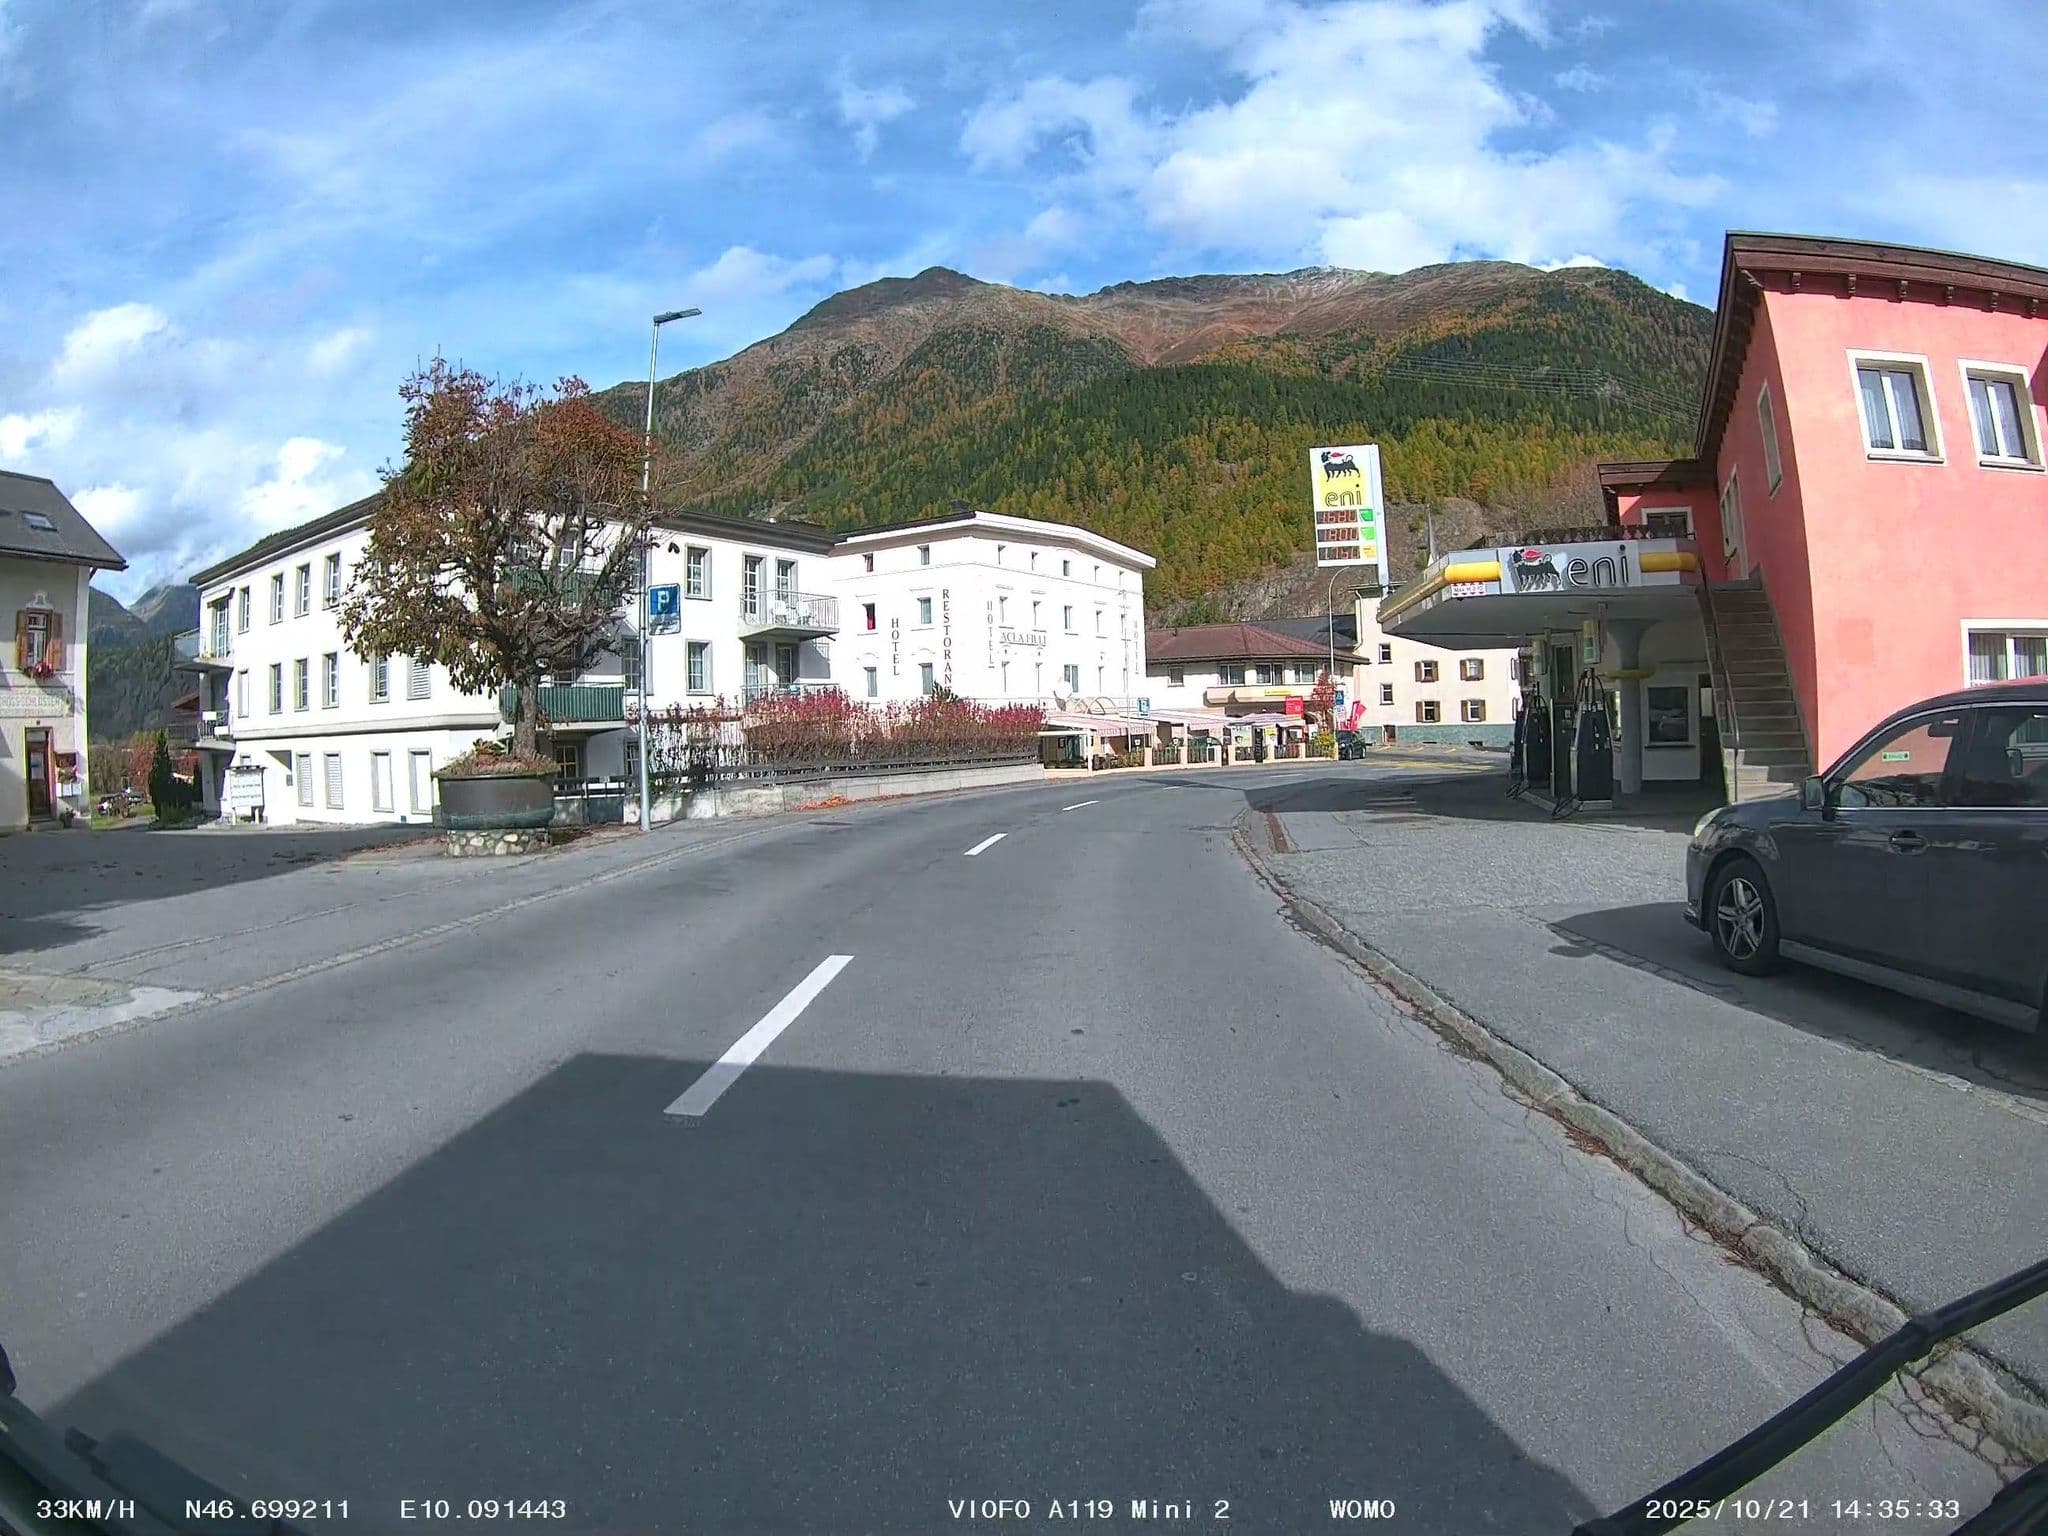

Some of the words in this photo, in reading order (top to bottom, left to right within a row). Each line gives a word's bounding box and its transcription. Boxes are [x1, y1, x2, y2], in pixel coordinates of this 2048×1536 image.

[1325, 483, 1362, 507] eni
[1567, 544, 1629, 586] eni
[657, 590, 670, 612] P
[891, 617, 900, 676] HOTEL
[942, 588, 952, 690] RESTORAN
